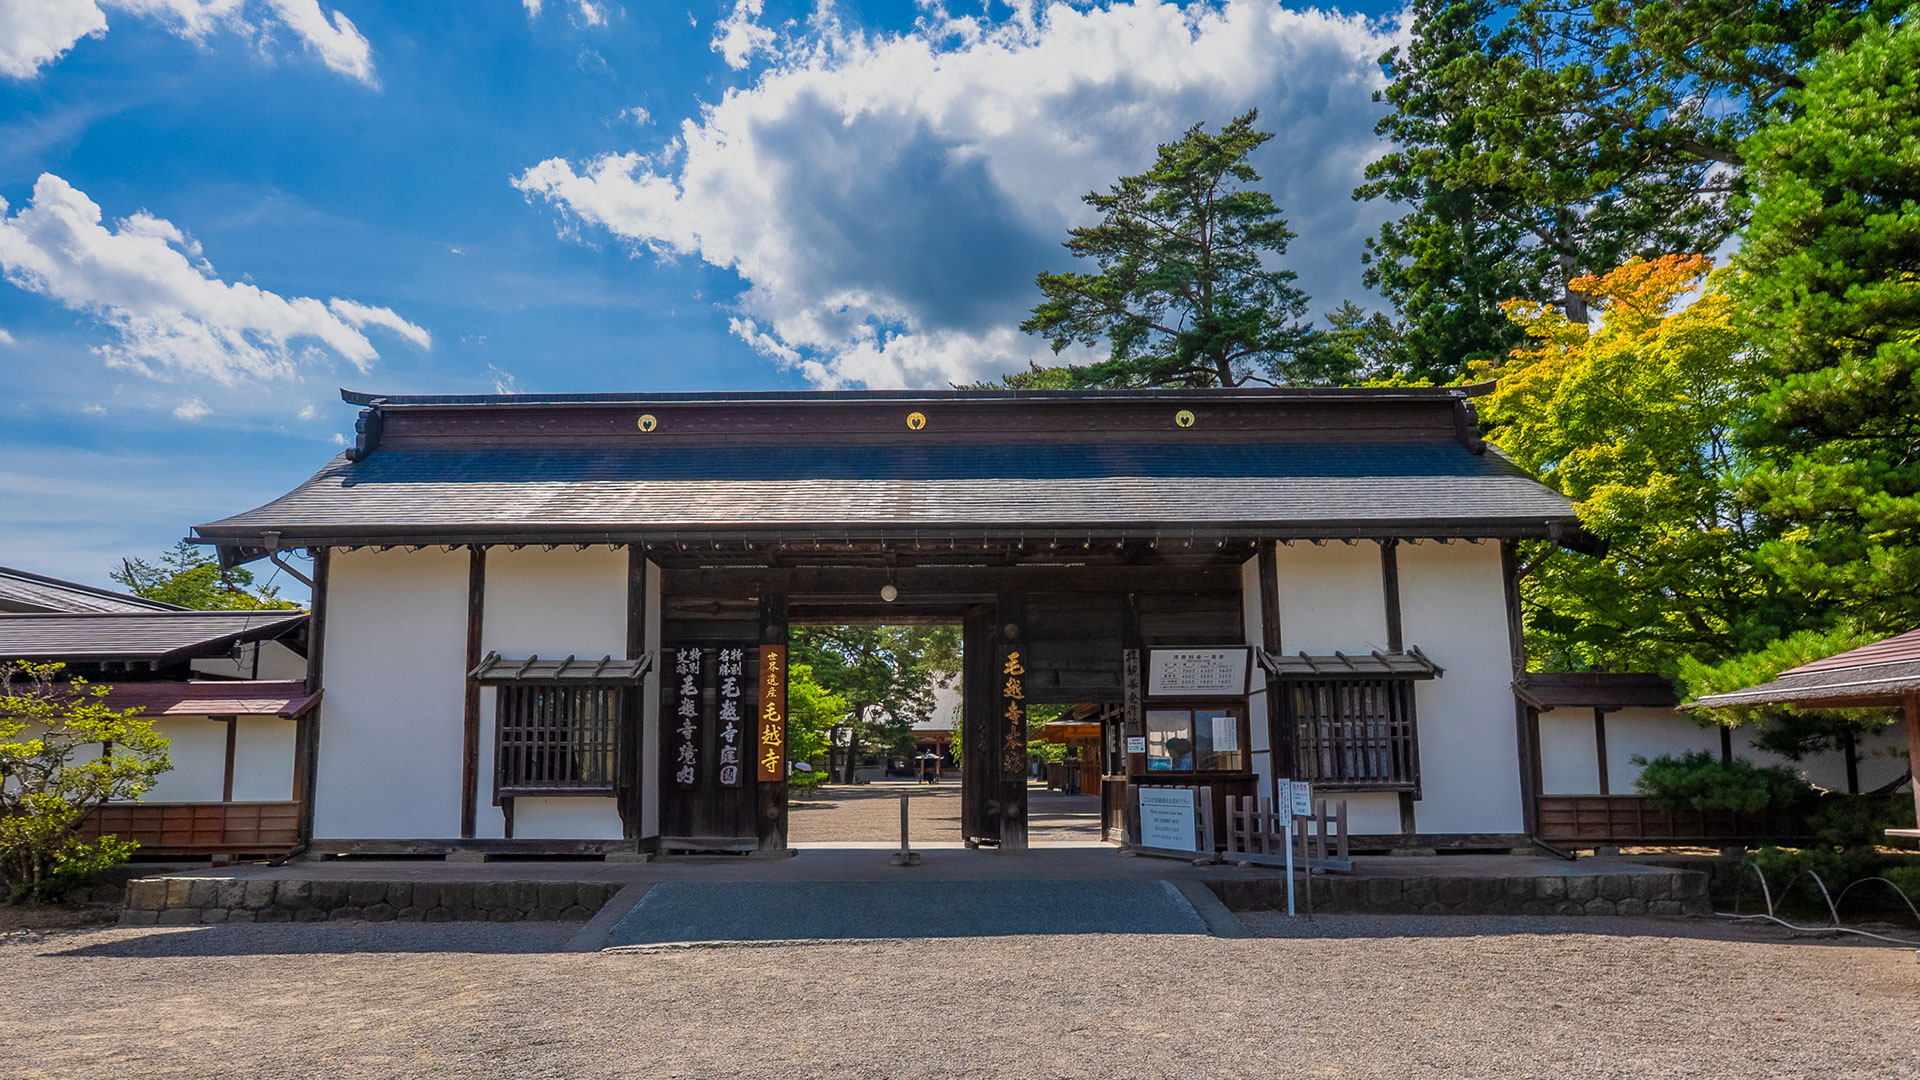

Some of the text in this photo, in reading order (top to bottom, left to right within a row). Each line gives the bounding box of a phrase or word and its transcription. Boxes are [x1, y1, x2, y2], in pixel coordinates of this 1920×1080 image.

[767, 652, 780, 698] 世界遺産
[676, 675, 698, 784] 毛越寺境内
[719, 677, 741, 785] 毛越寺庭園
[761, 702, 783, 773] 毛越寺
